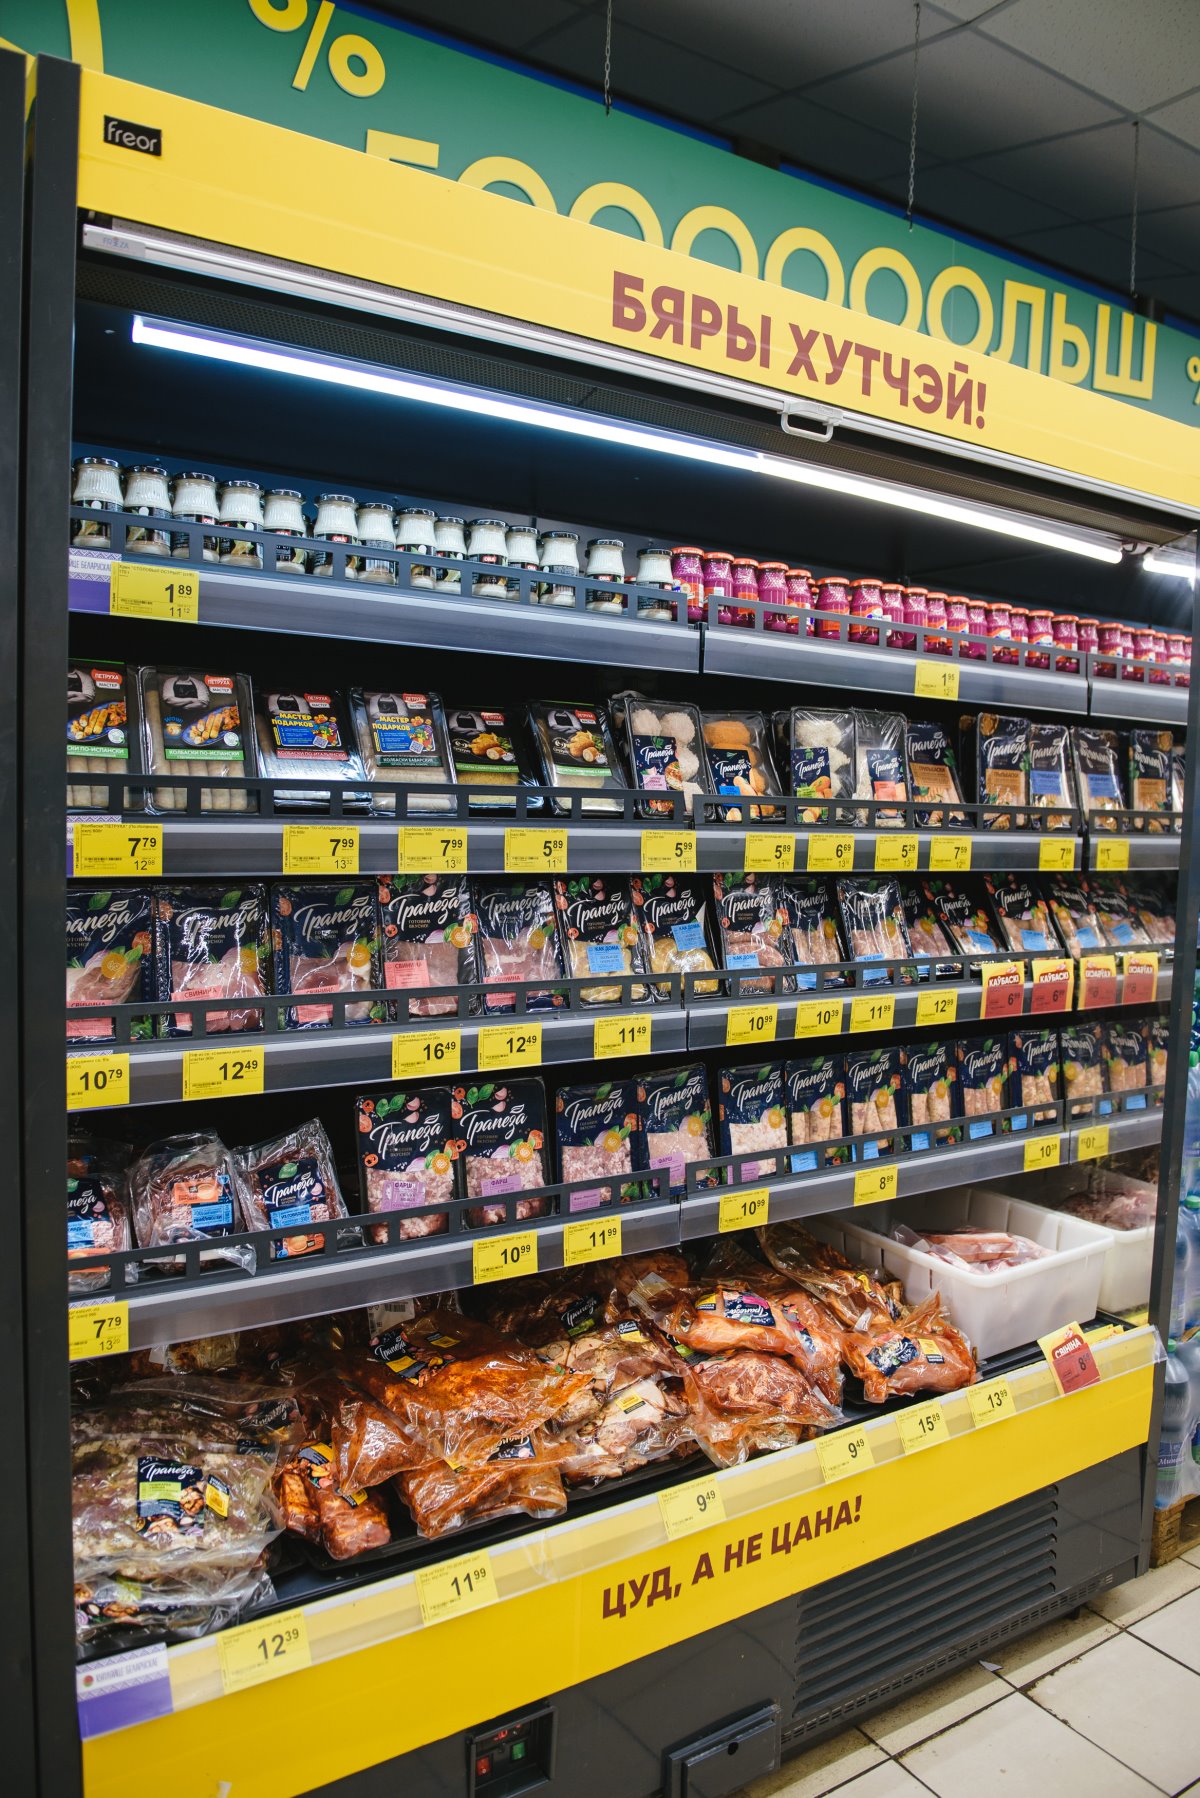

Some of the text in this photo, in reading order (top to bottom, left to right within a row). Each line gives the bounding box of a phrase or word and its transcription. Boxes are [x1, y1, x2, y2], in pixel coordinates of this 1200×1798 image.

[107, 121, 158, 153] freor
[612, 270, 988, 430] БЯРЫ ХУТЧЭЙ!
[94, 671, 119, 681] ПЕТРУХА
[207, 678, 230, 687] ПЕТРУХА
[272, 718, 314, 728] ПОДАРКОВ
[279, 712, 312, 721] МАСТЕР
[372, 722, 411, 731] ПОДАРКОВ
[379, 715, 410, 724] МАСТЕР
[293, 902, 374, 942] Трапеза
[388, 893, 461, 931] Трапеза
[567, 899, 626, 933] Трапеза
[643, 895, 697, 923] Трапеза
[721, 891, 773, 923] Трапеза
[988, 974, 1020, 988] КАЎБАСКІ
[1039, 972, 1070, 984] КАЎБАСКІ
[849, 1059, 891, 1092] Трапеза
[908, 1051, 947, 1083] Трапеза
[731, 1078, 782, 1112] Трапеза
[788, 1067, 834, 1101] Трапеза
[564, 1097, 624, 1134] Трапеза
[647, 1083, 703, 1121] Трапеза
[369, 1121, 444, 1160] Трапеза
[459, 1109, 528, 1146] Трапеза
[264, 1177, 315, 1207] Трапеза
[1054, 1337, 1083, 1360] СВІНІНА
[139, 1461, 196, 1482] Трапеза
[602, 1495, 862, 1619] ЦУД, А НЕ ЦАНА!
